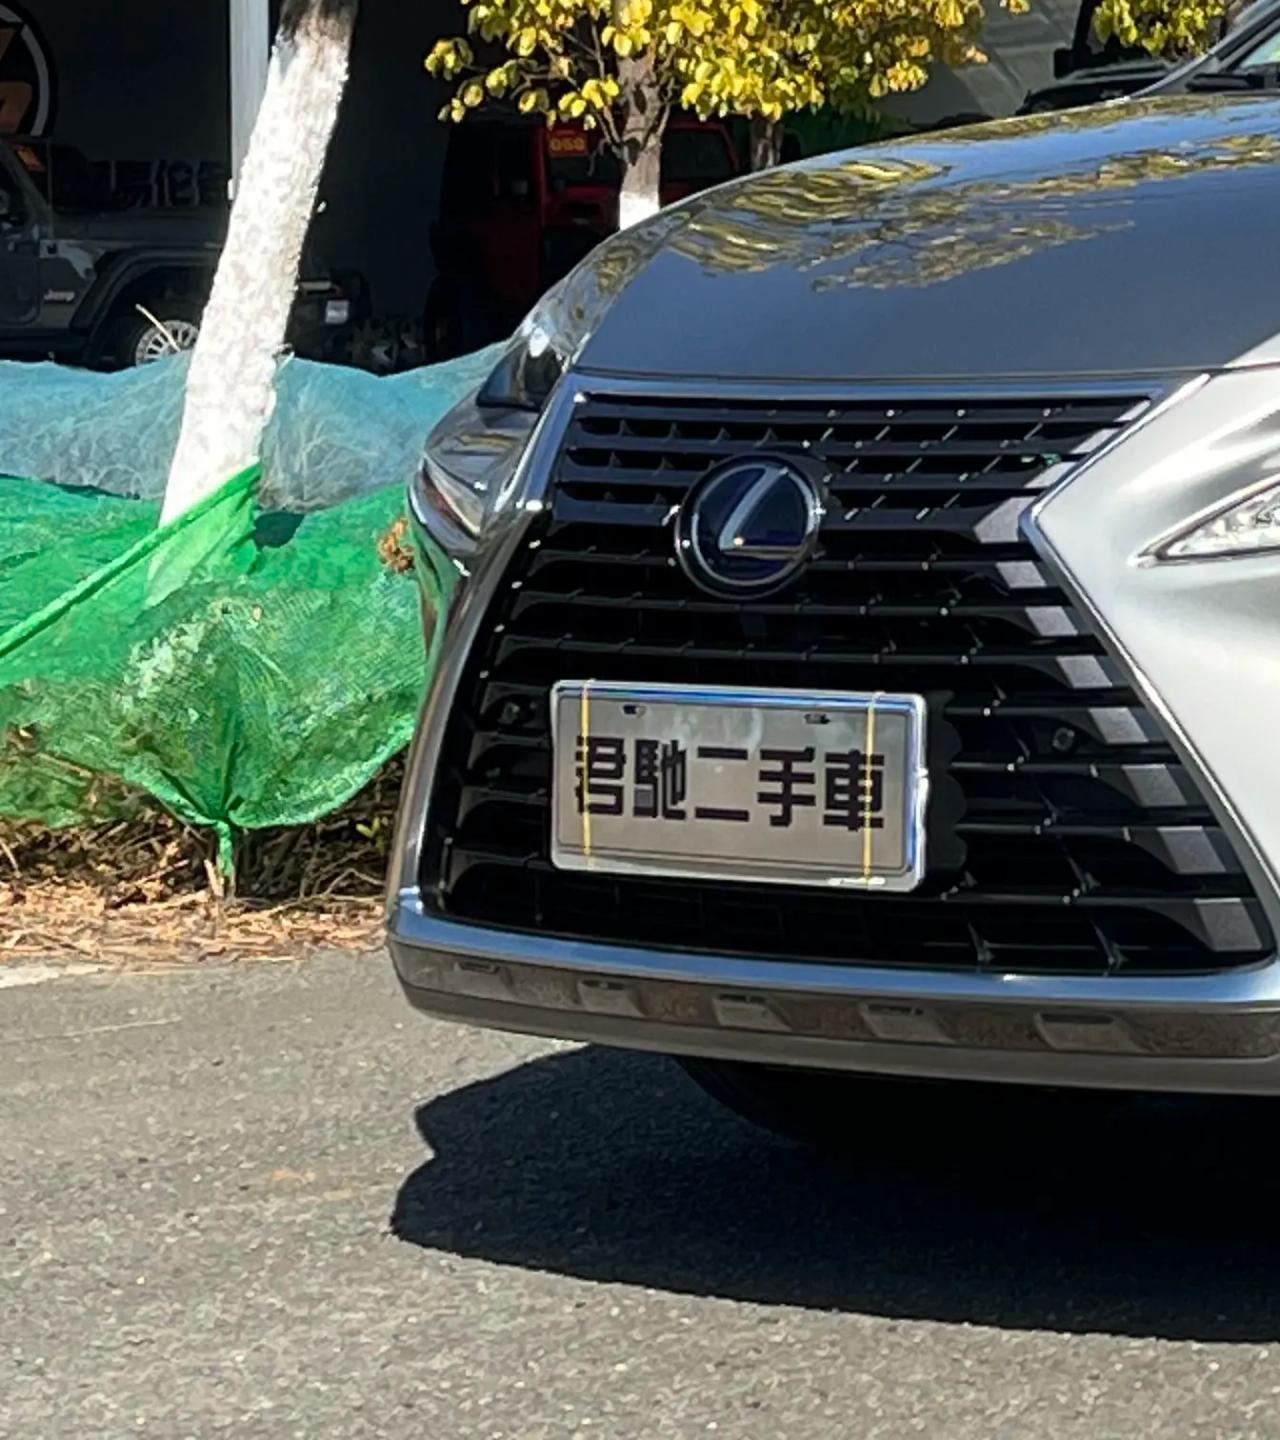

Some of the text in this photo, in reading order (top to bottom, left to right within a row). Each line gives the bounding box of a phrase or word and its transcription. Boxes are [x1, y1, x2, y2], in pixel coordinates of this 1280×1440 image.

[575, 735, 885, 831] 君馳二手車
